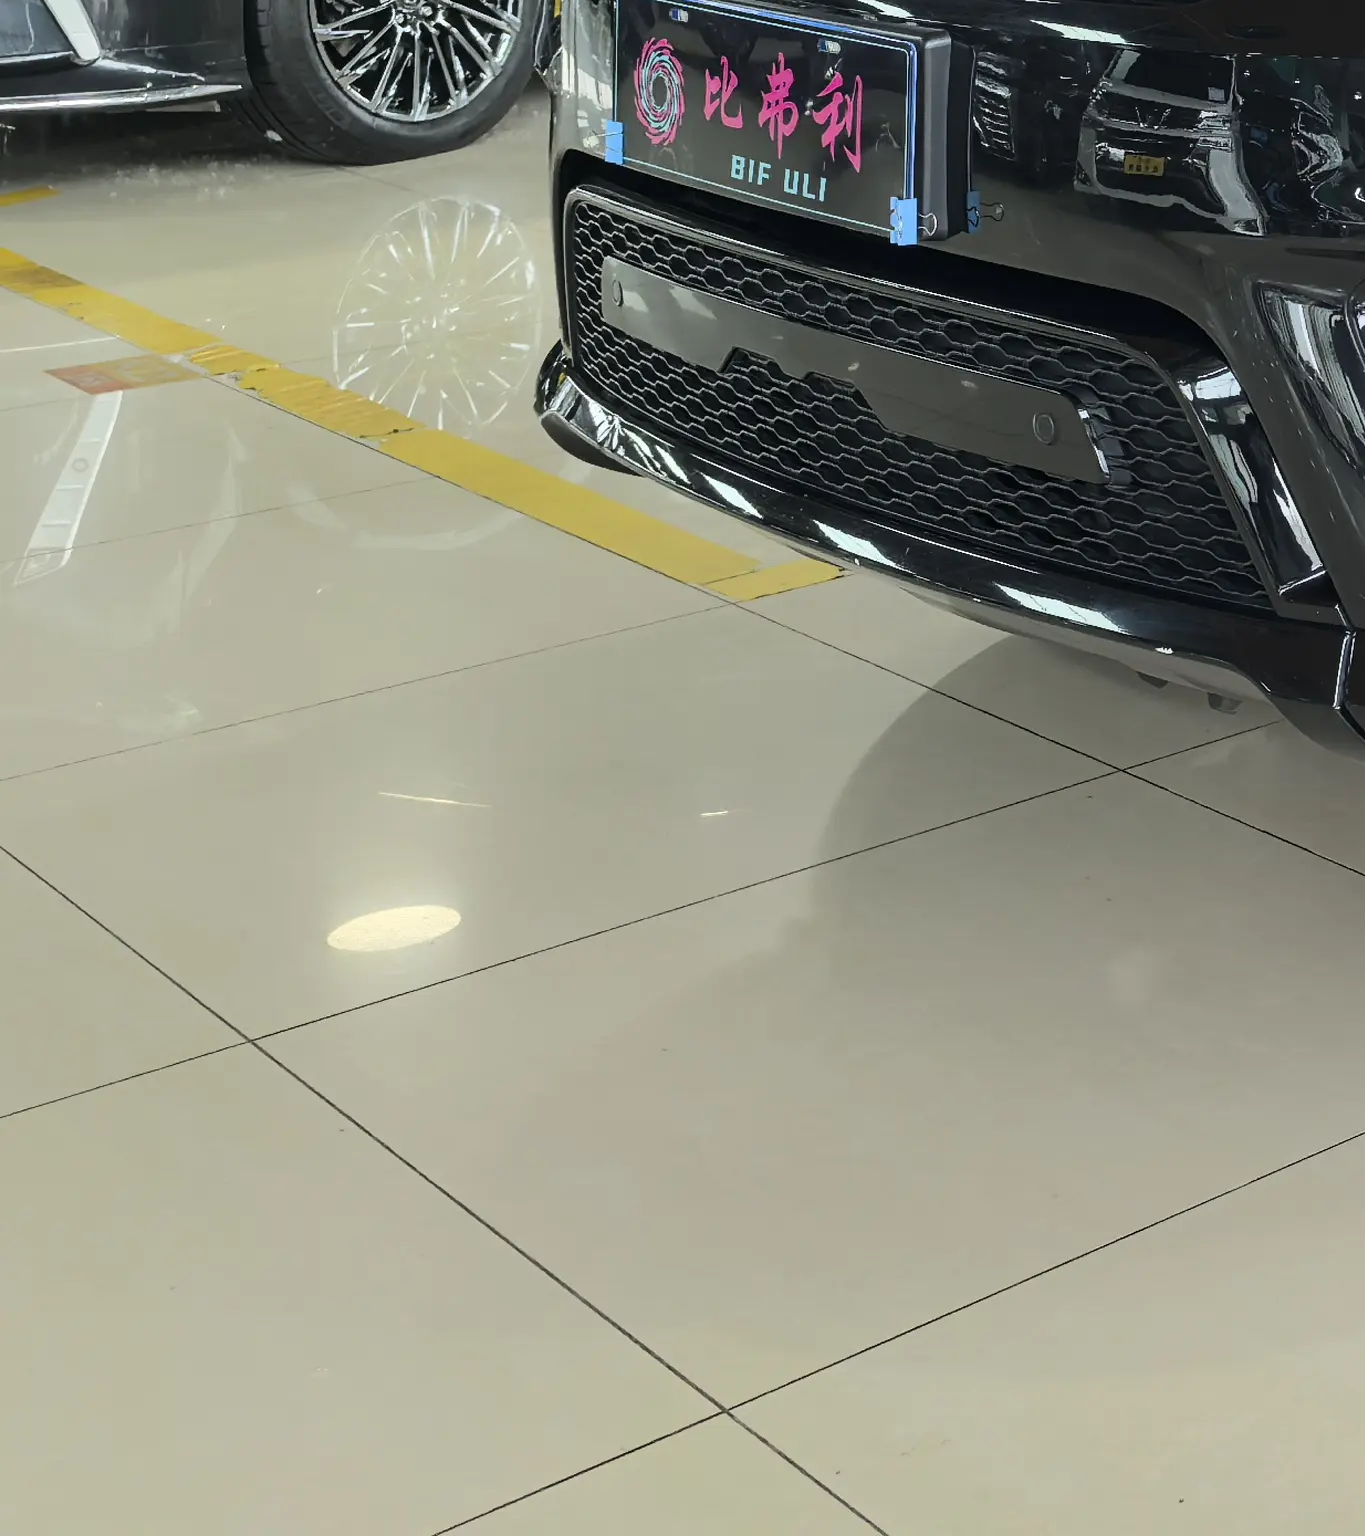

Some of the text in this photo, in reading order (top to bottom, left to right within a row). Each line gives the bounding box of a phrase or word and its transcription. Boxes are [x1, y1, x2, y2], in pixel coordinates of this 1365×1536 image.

[703, 51, 864, 174] 比弗利
[730, 154, 828, 203] BIF ULI
